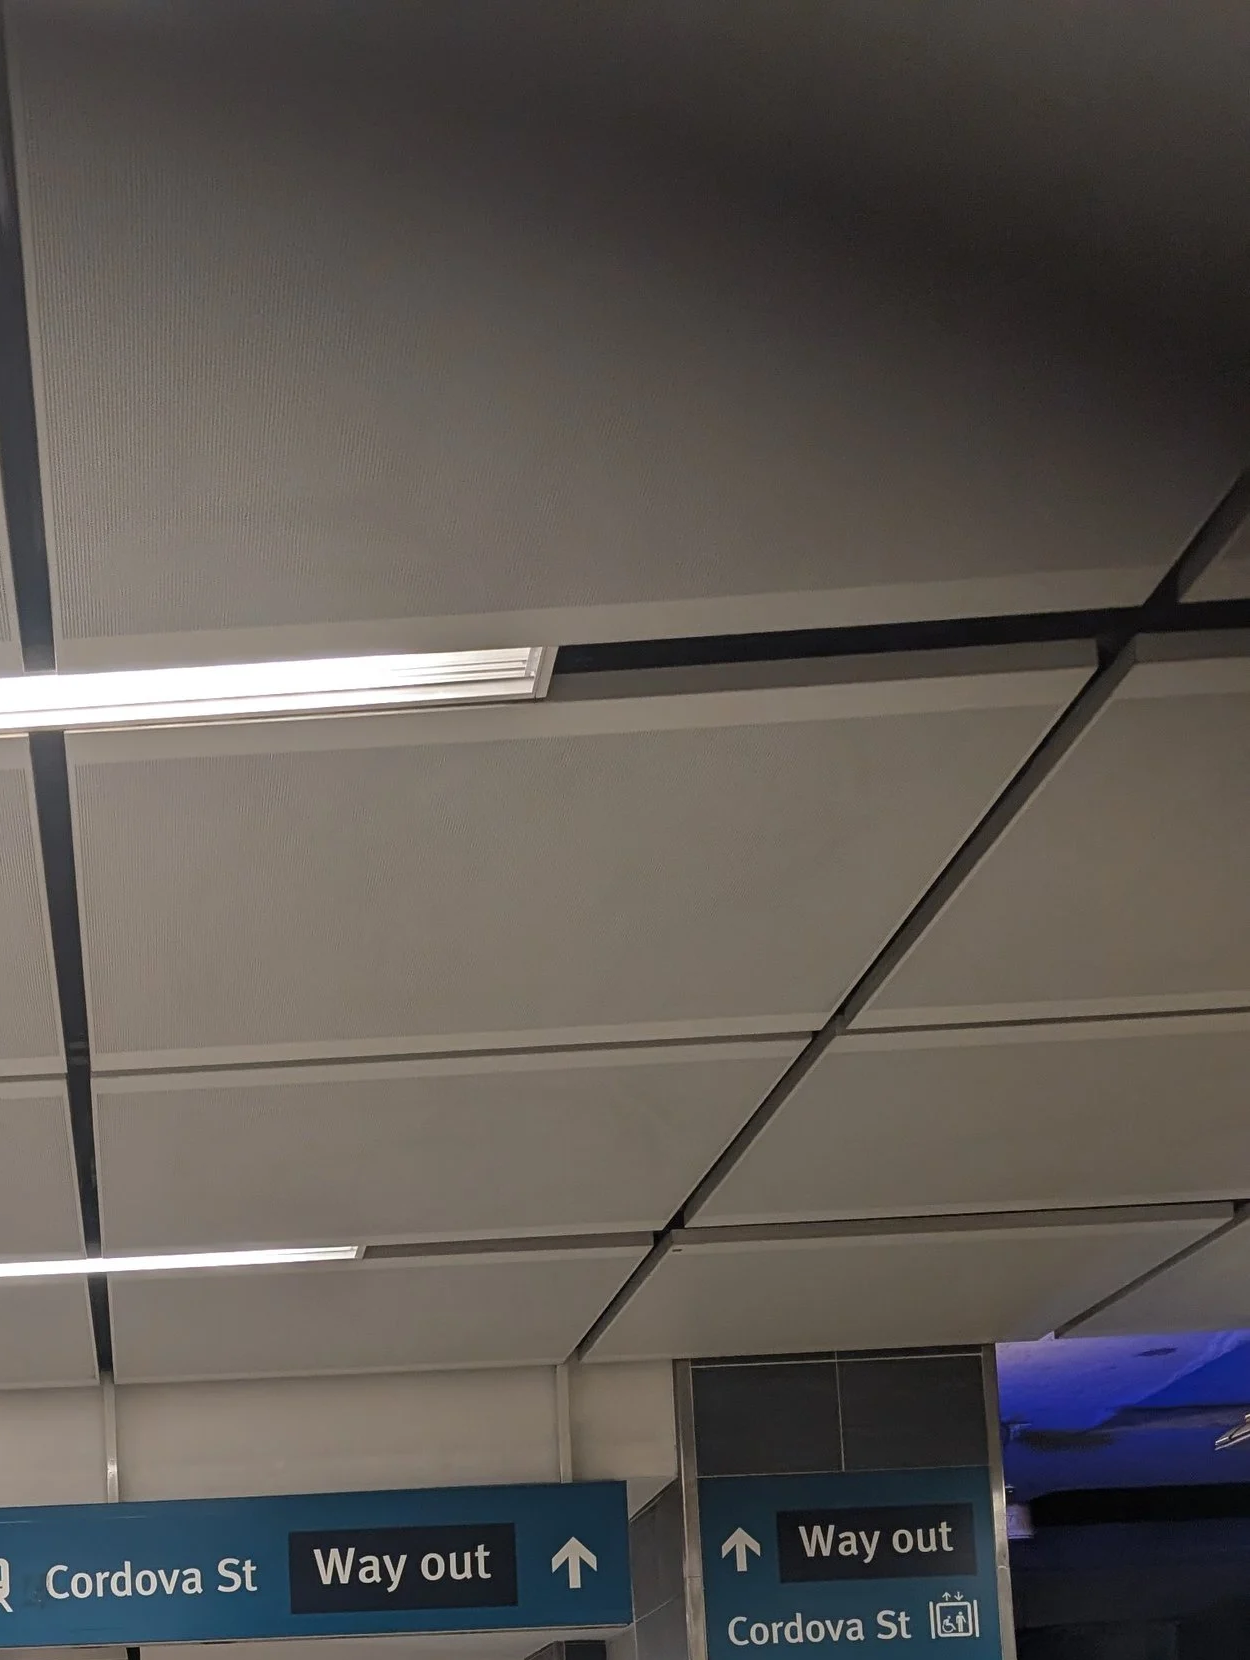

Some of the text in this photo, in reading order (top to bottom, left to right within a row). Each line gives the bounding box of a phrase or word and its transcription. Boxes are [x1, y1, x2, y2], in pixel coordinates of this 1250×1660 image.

[798, 1522, 953, 1563] Way out
[46, 1558, 257, 1599] Cordova St
[314, 1544, 491, 1592] Way out
[728, 1610, 911, 1645] Cordova St
